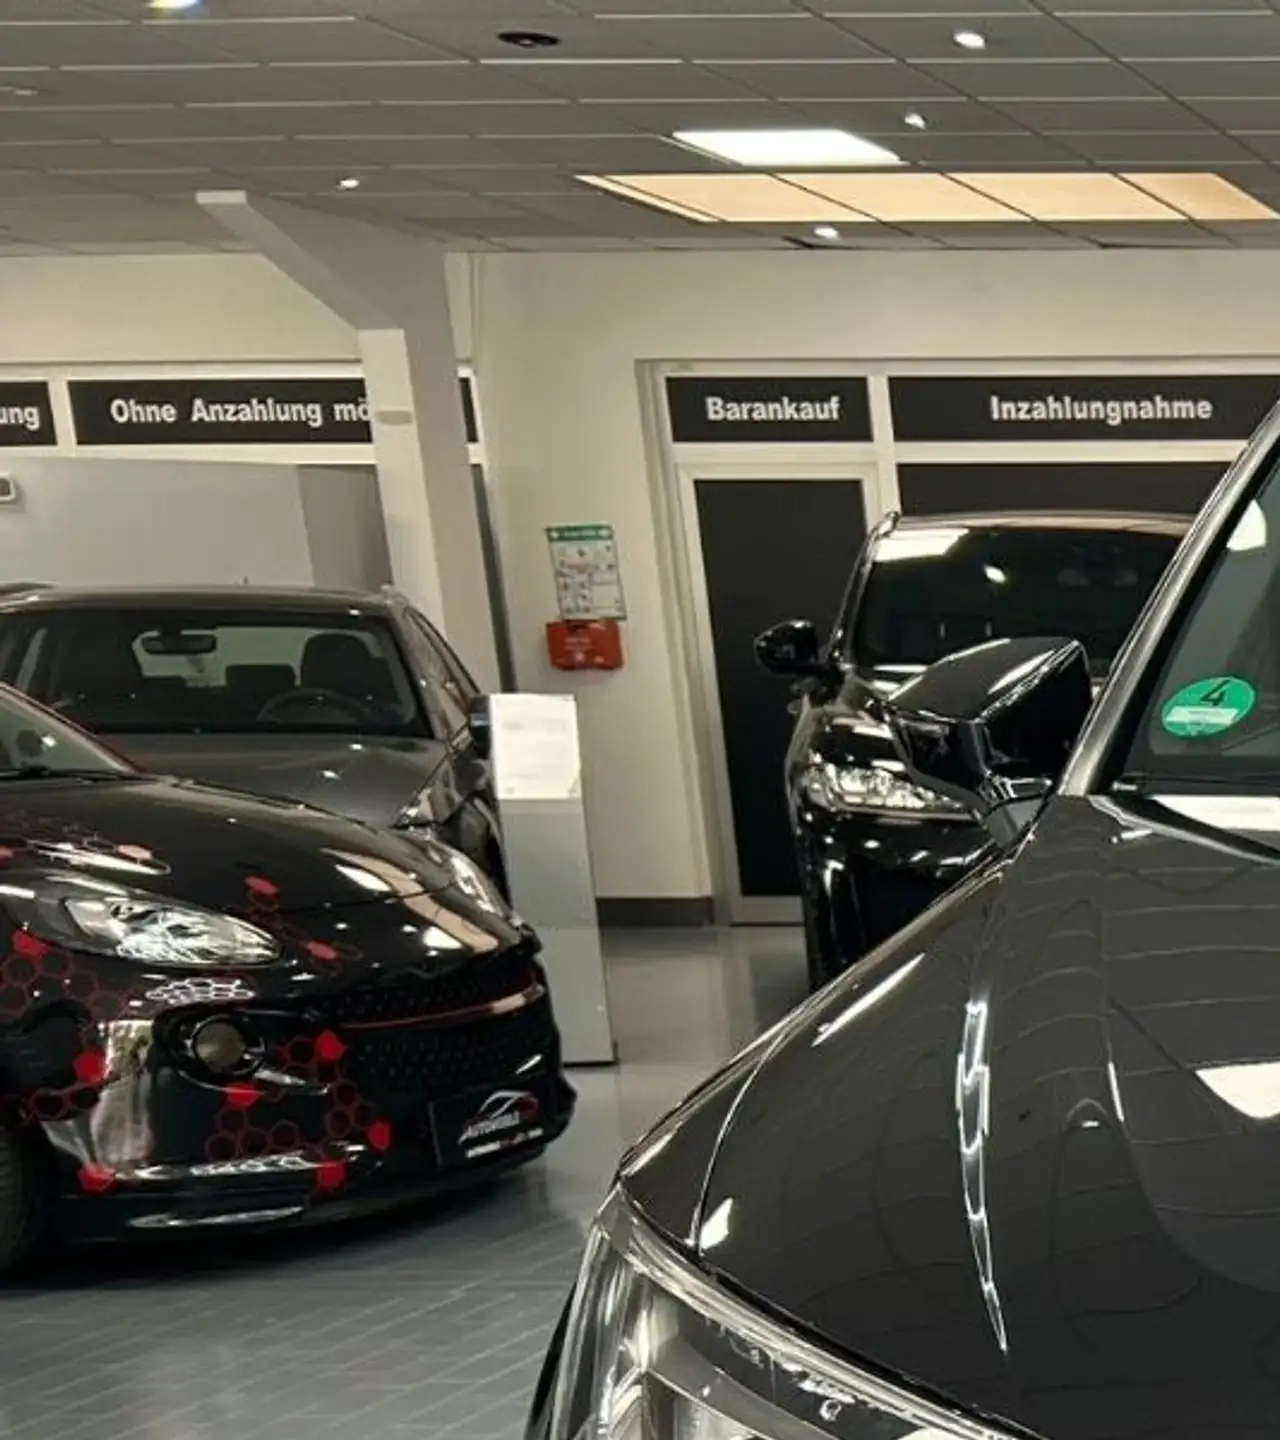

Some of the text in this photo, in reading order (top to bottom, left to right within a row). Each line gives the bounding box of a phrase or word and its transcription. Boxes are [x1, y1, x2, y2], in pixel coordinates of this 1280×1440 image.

[110, 399, 177, 423] Ohne
[191, 398, 323, 428] Anzahlung
[706, 397, 841, 421] Barankauf
[990, 395, 1214, 426] Inzahlungnahme
[1200, 679, 1230, 707] 4
